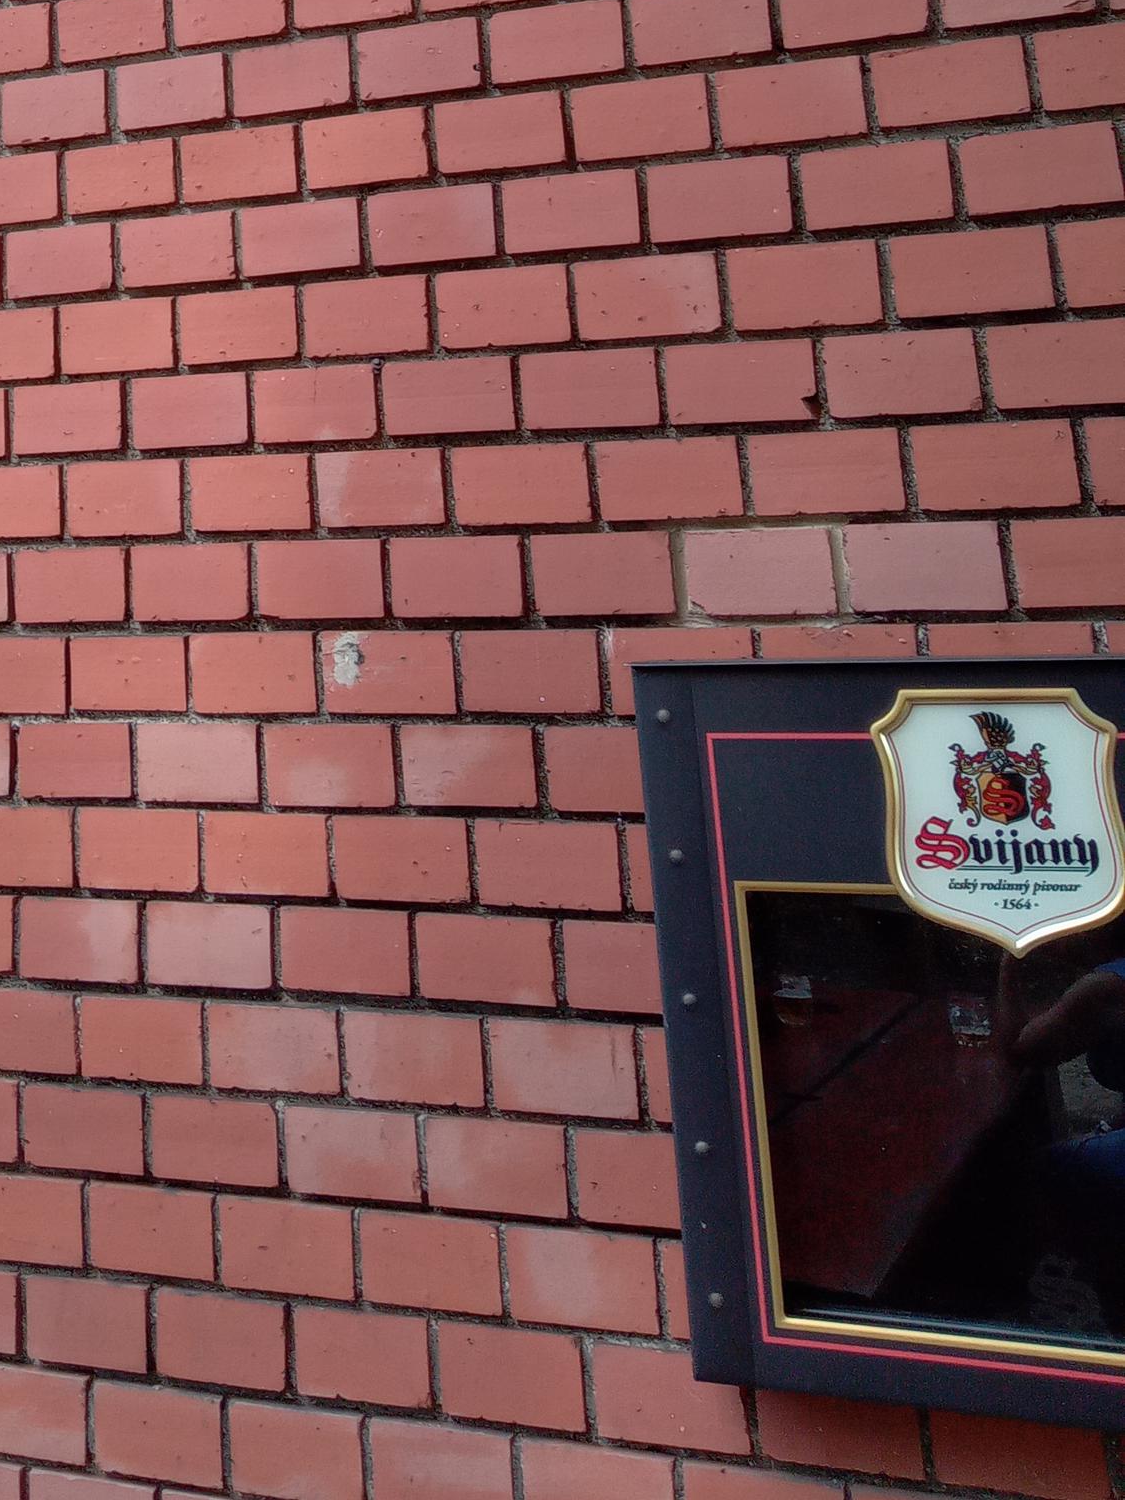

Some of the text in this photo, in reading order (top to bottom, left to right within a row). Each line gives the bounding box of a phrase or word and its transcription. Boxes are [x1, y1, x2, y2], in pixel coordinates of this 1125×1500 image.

[914, 816, 1100, 878] Svijany
[980, 878, 1030, 895] rodinný
[1032, 880, 1082, 896] pivovar
